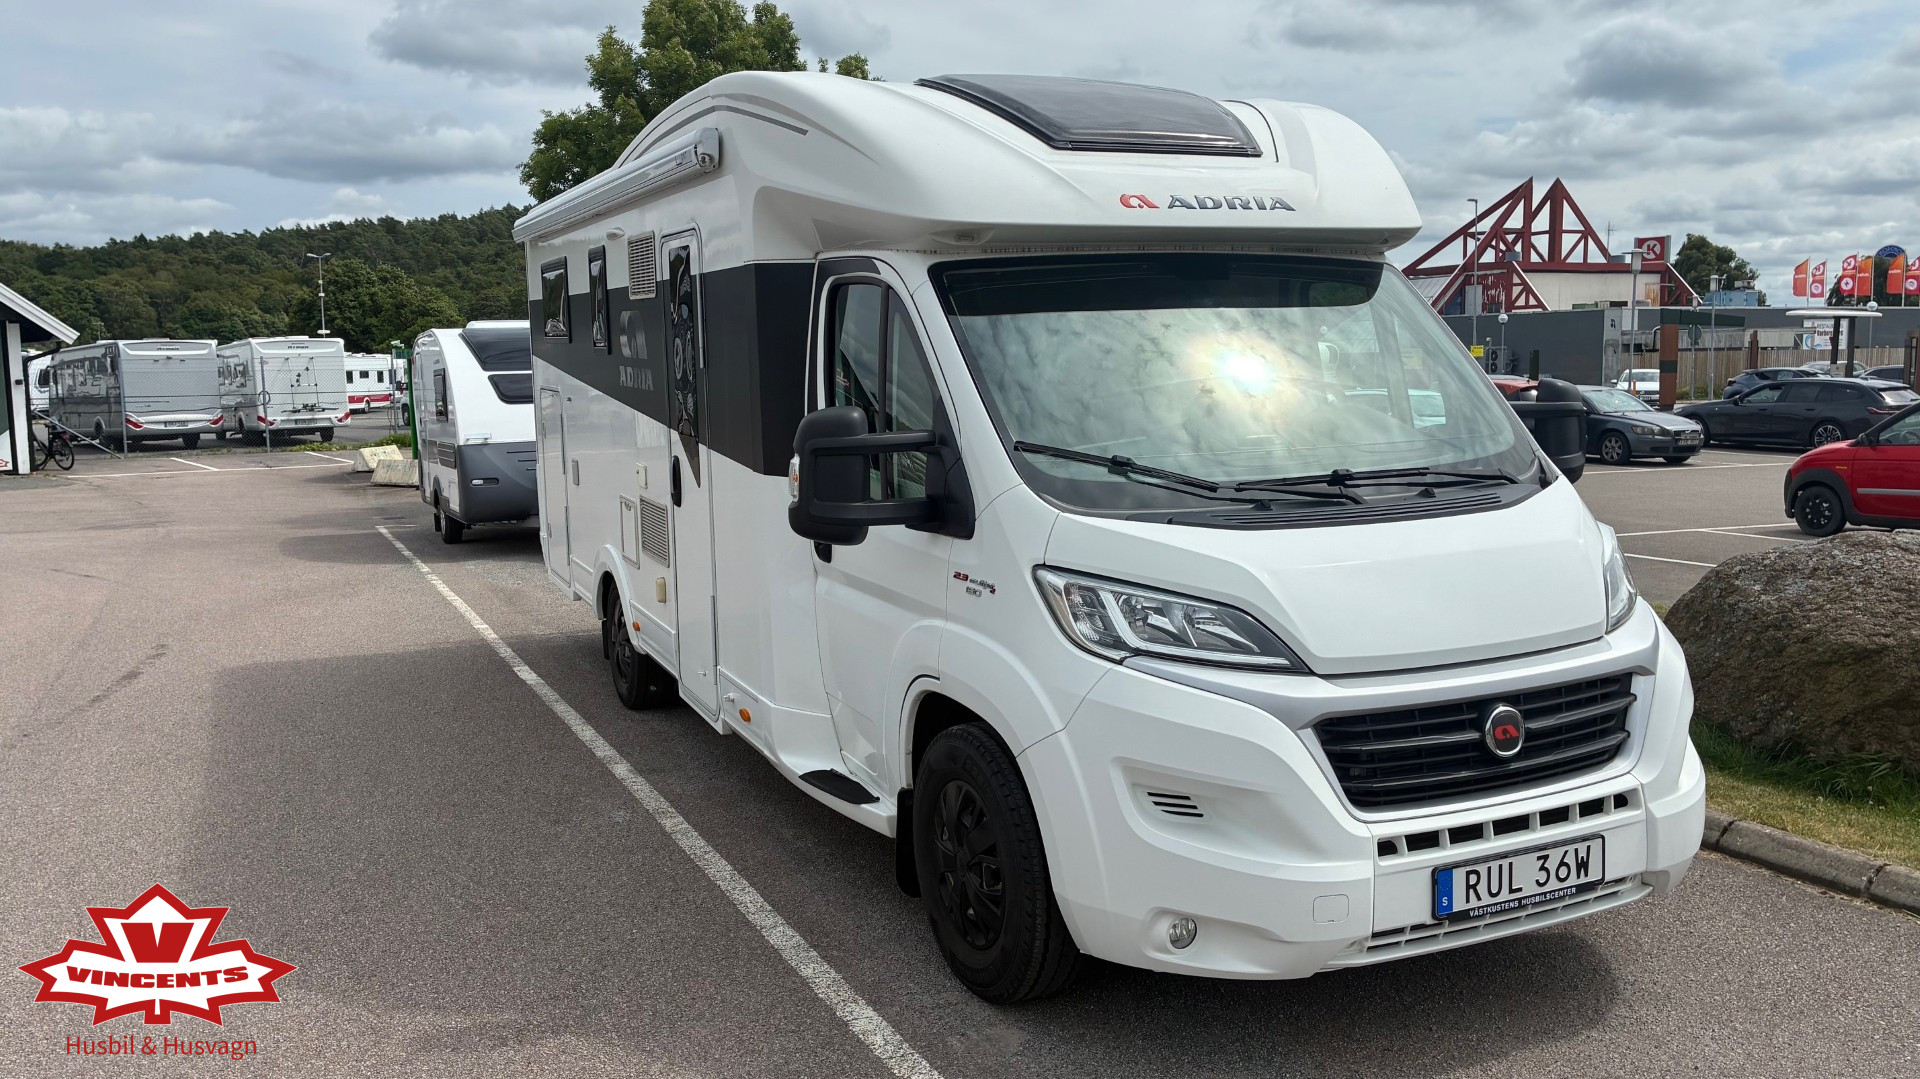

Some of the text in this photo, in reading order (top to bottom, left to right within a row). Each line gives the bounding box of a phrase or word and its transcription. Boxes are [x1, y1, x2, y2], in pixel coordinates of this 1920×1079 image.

[1167, 194, 1297, 212] ADRIA
[618, 365, 654, 391] ADRIA
[1465, 844, 1592, 904] RUL 36W
[1441, 896, 1449, 907] S
[1469, 887, 1577, 918] VÄSTKUSTENS HUSBILSCENTER
